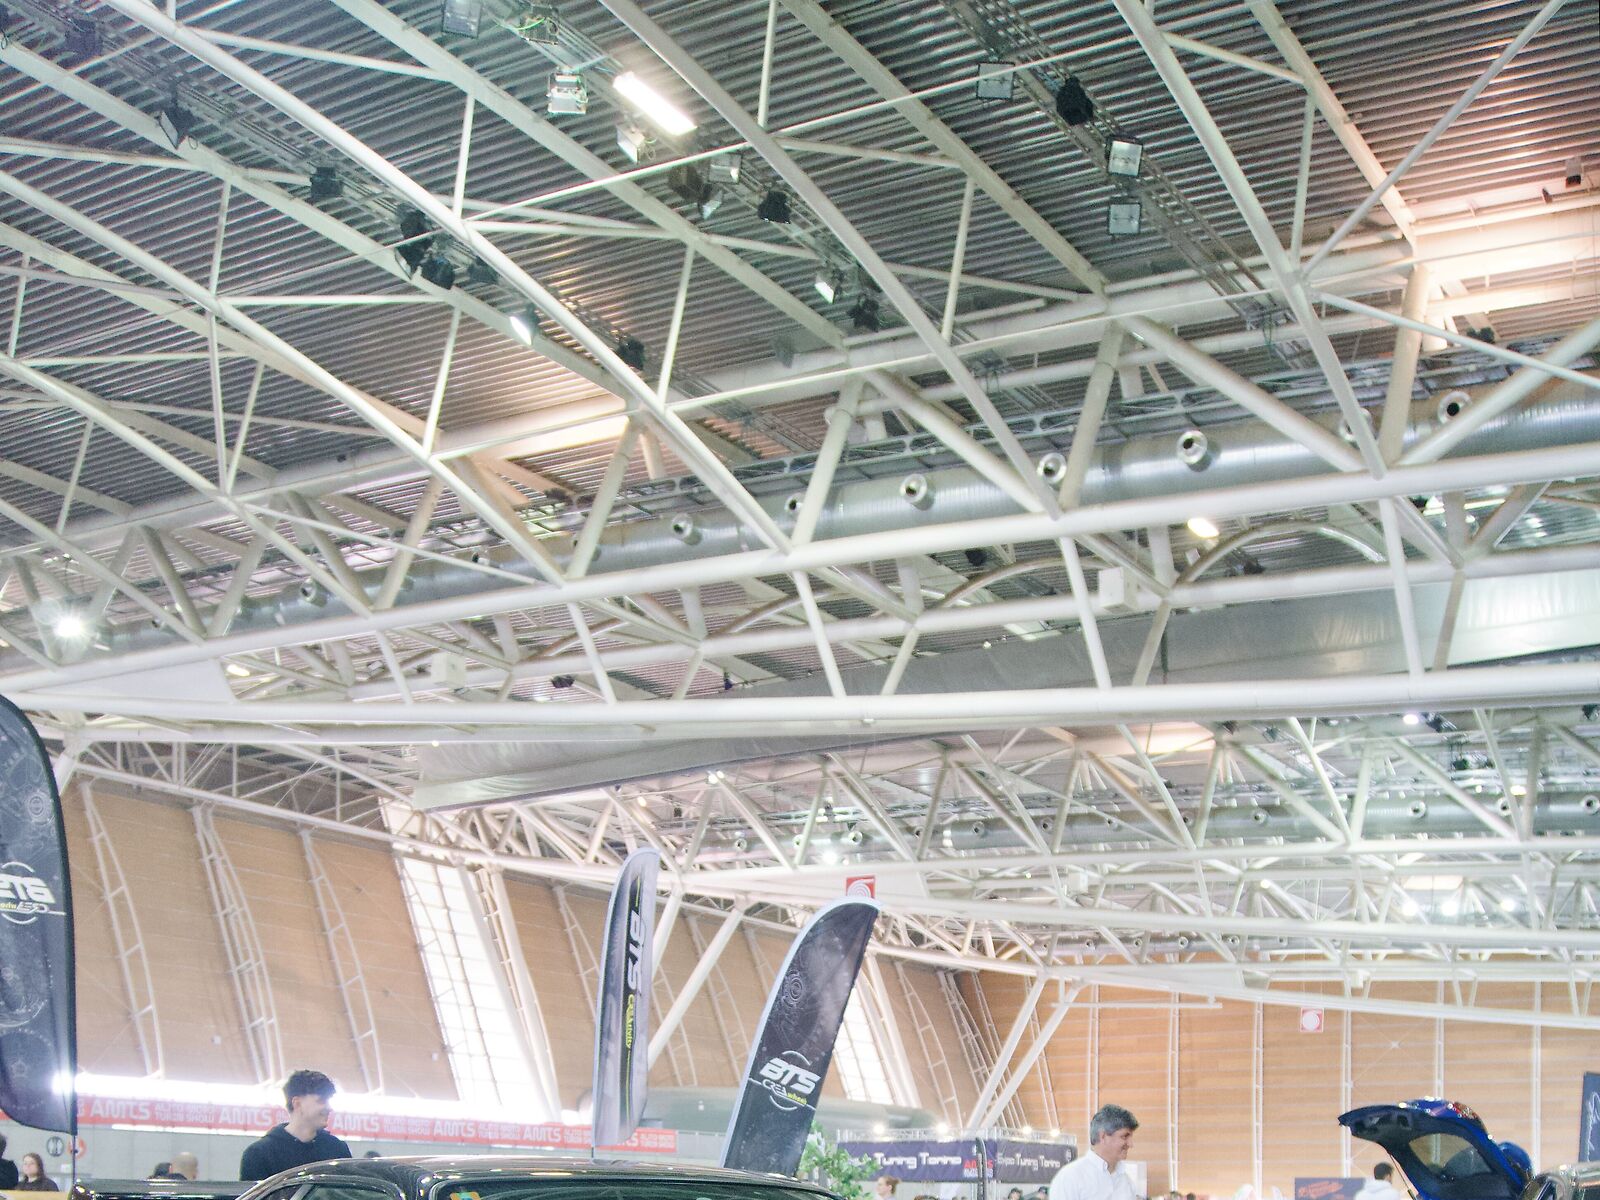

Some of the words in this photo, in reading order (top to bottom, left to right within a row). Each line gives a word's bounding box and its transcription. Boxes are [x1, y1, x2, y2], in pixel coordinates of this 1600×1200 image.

[759, 1057, 822, 1095] BTS
[874, 1152, 917, 1169] Tuning
[919, 1152, 961, 1165] Torino
